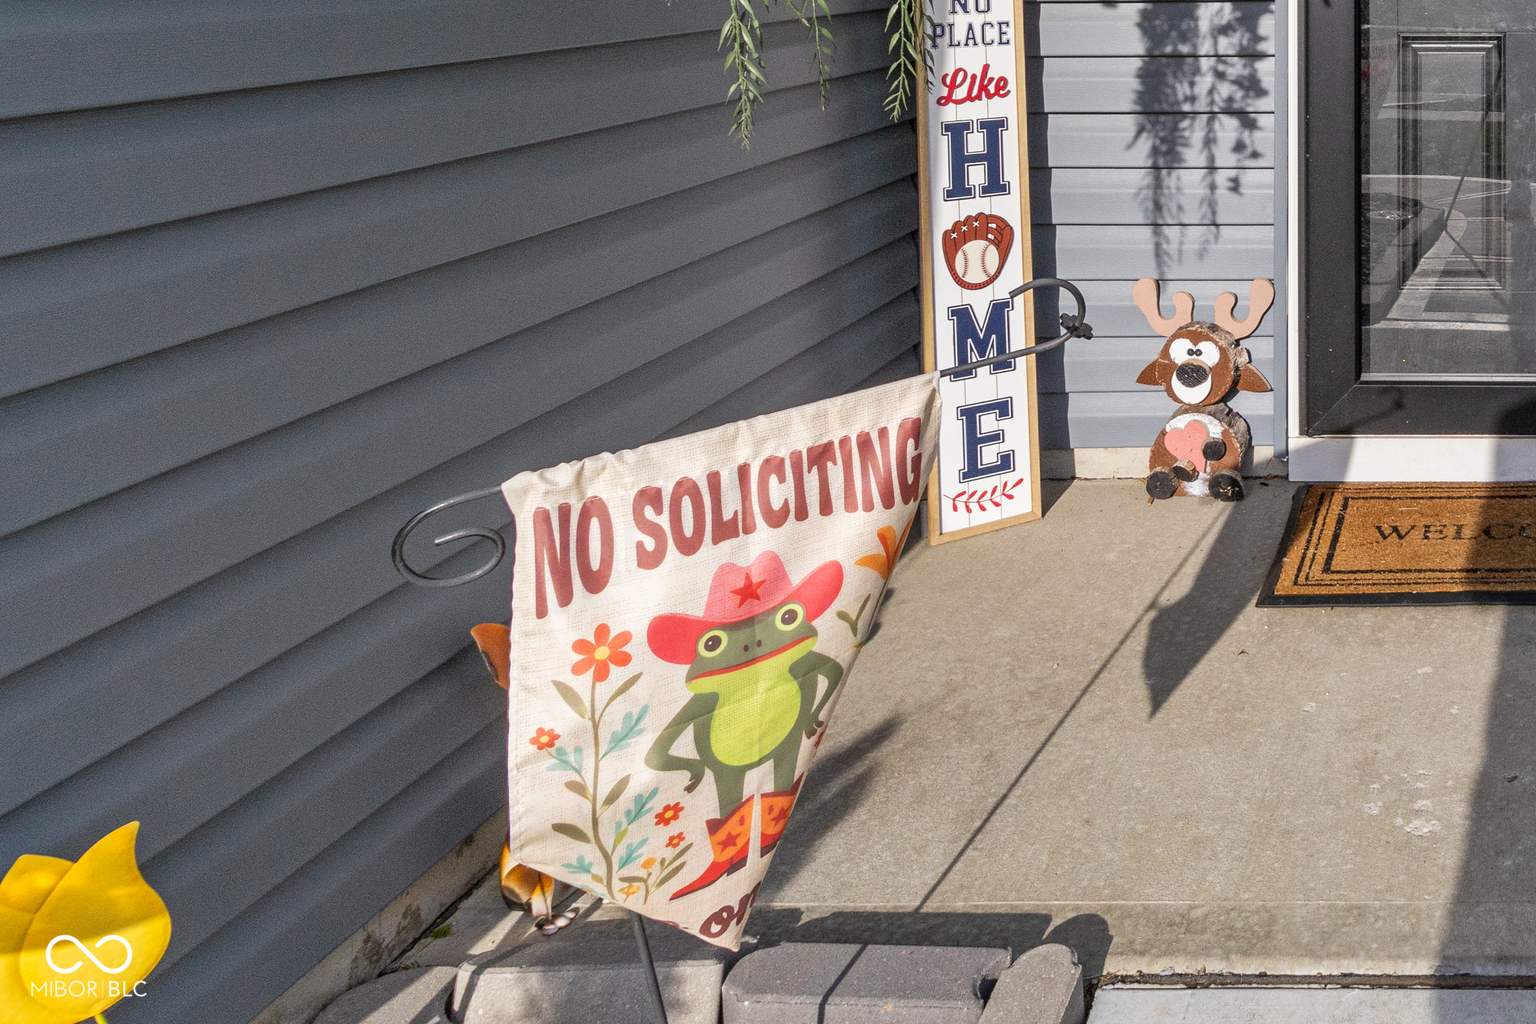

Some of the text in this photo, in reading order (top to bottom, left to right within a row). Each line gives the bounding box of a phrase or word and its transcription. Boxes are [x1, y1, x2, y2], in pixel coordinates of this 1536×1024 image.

[930, 21, 1011, 50] PLACE
[936, 63, 1011, 106] Like
[533, 417, 922, 619] NO SOLICITING
